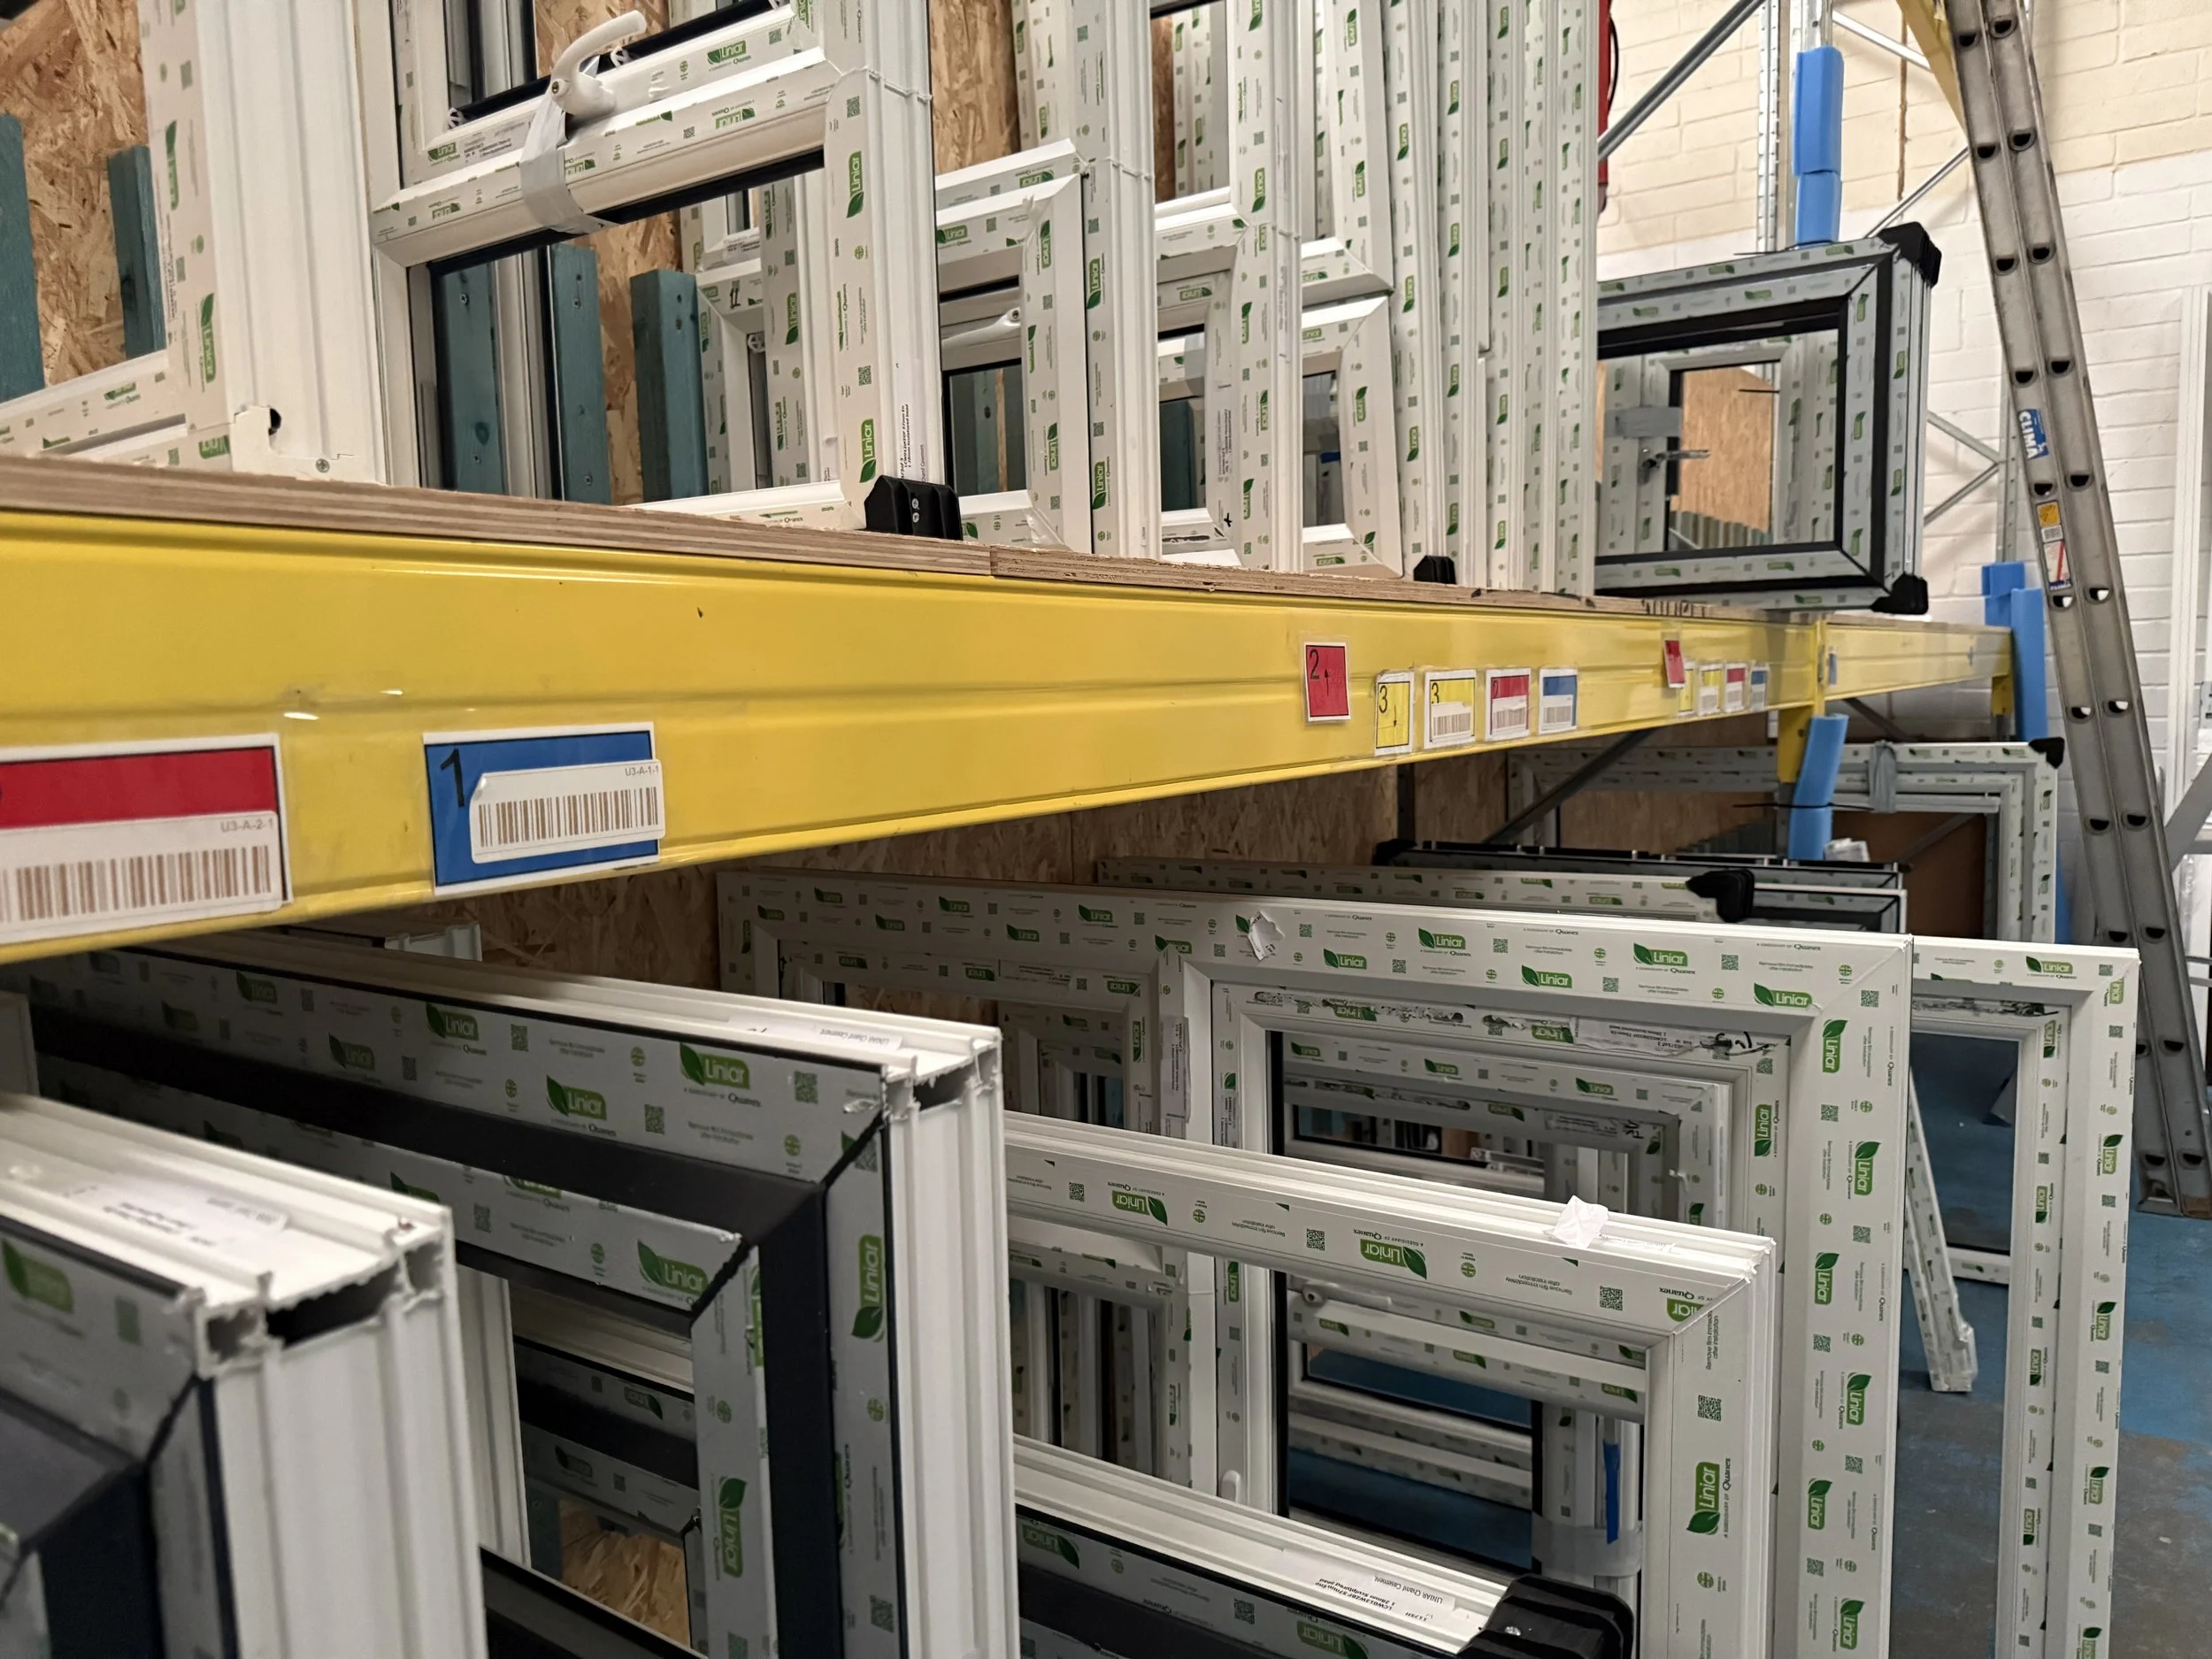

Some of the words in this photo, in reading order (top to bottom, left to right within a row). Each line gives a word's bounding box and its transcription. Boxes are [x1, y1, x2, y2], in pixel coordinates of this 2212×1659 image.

[721, 43, 745, 58] Liniar
[851, 157, 861, 193] Liniar
[1091, 263, 1100, 288] Liniar
[863, 423, 873, 458] Liniar
[2018, 411, 2039, 460] CLIMA
[1050, 442, 1059, 469] Liniar
[1096, 465, 1106, 492] Liniar
[1309, 649, 1320, 681] 2
[1379, 684, 1389, 715] 3
[440, 749, 465, 809] 1
[625, 764, 659, 777] U3-A-1-1
[1091, 911, 1112, 923] Liniar
[1436, 934, 1463, 949] Liniar
[1340, 955, 1365, 970] Liniar
[1653, 951, 1685, 965] Liniar
[2044, 961, 2070, 973] Liniar
[1540, 972, 1570, 987] Liniar
[1776, 992, 1809, 1006] Liniar
[445, 1015, 476, 1037] Liniar
[1824, 1039, 1839, 1070] Liniar
[704, 1059, 747, 1086] Liniar
[570, 1091, 604, 1116] Liniar
[727, 1091, 762, 1108] Quanex
[1757, 1108, 1770, 1139] Liniar
[1857, 1161, 1870, 1192] Liniar
[1115, 1193, 1146, 1212] Liniar
[1353, 1229, 1383, 1240] Quanex
[1363, 1240, 1402, 1261] Liniar
[664, 1263, 704, 1295] Liniar
[864, 1241, 883, 1304] Liniar
[1659, 1286, 1695, 1301] Quanex
[1816, 1271, 1830, 1302] Liniar
[1848, 1392, 1863, 1422] Liniar
[1699, 1465, 1716, 1509] Liniar
[1809, 1497, 1824, 1528] Liniar
[724, 1513, 742, 1571] Liniar
[1374, 1575, 1402, 1591] Casement
[1422, 1588, 1444, 1605] LINIAR
[1303, 1624, 1342, 1652] Liniar
[1842, 1617, 1855, 1647] Liniar
